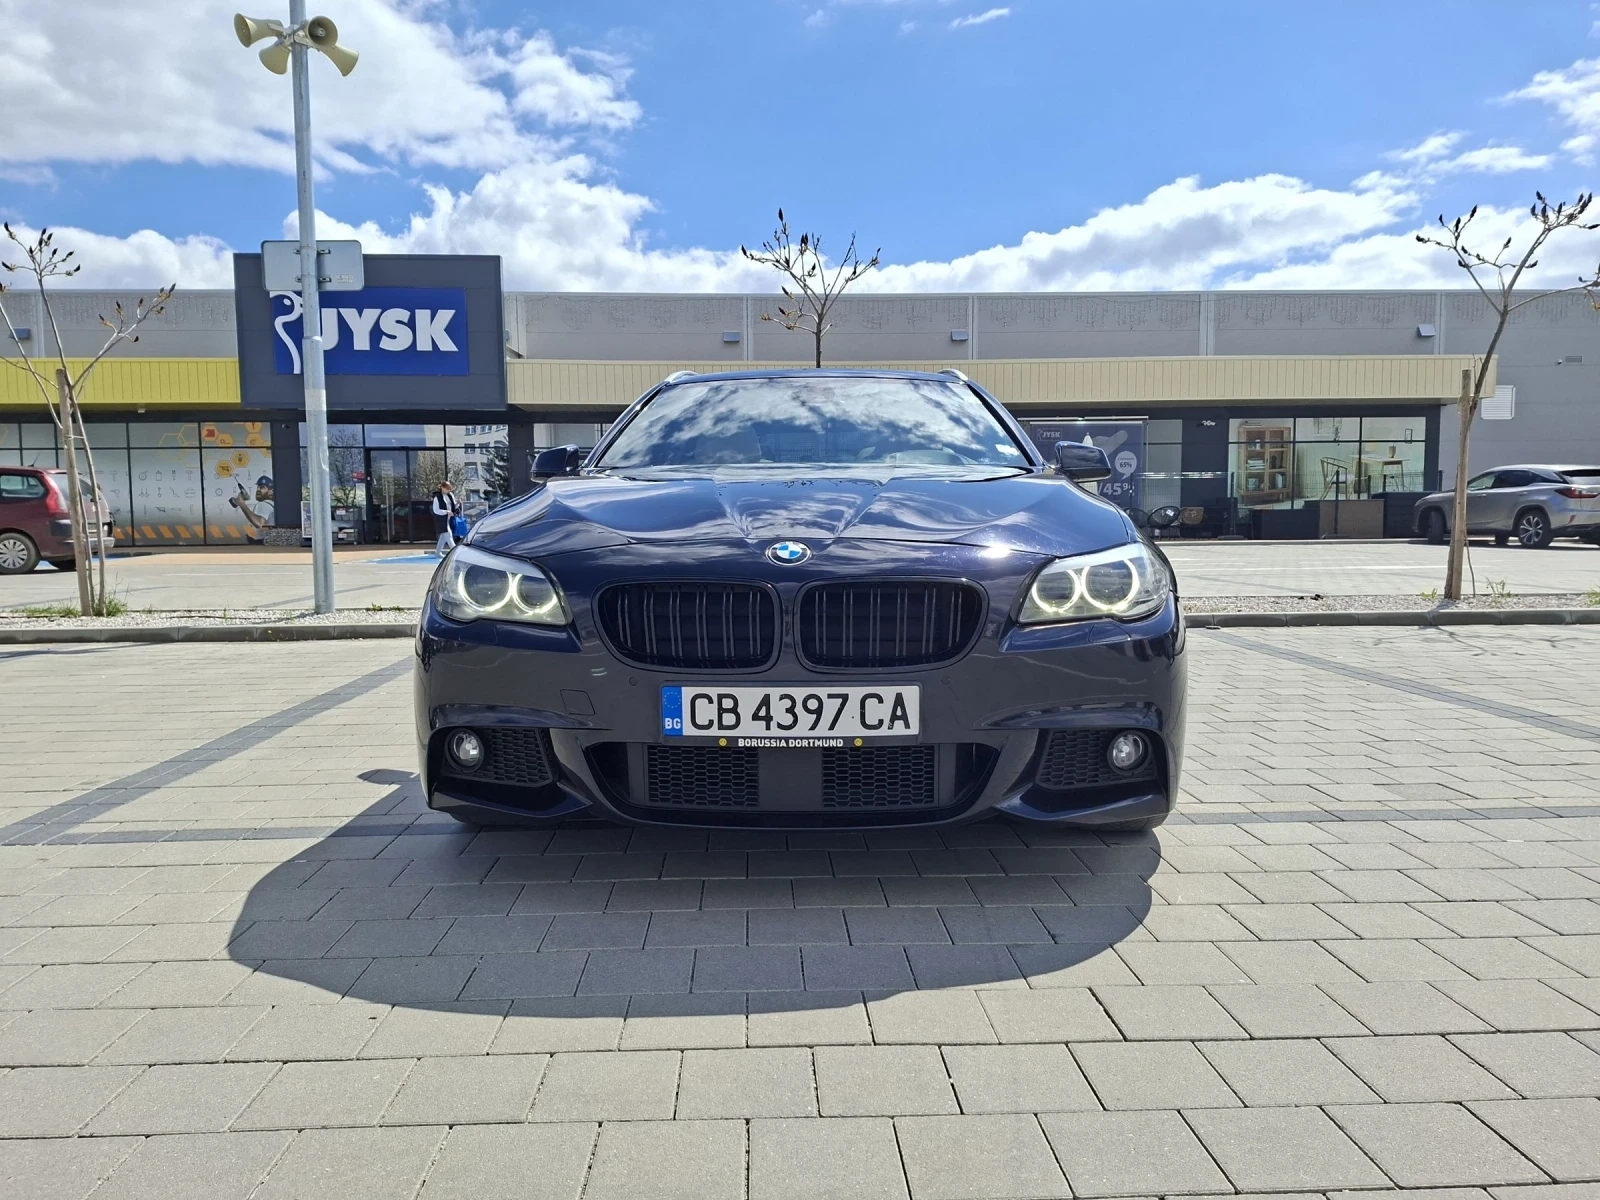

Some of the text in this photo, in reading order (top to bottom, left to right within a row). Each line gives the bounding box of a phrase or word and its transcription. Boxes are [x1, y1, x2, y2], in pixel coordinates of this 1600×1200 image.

[321, 307, 459, 352] JYSK
[664, 718, 682, 730] BG
[690, 692, 911, 732] CB 4397 CA
[737, 738, 844, 748] BORUSSIA DORTMUND
